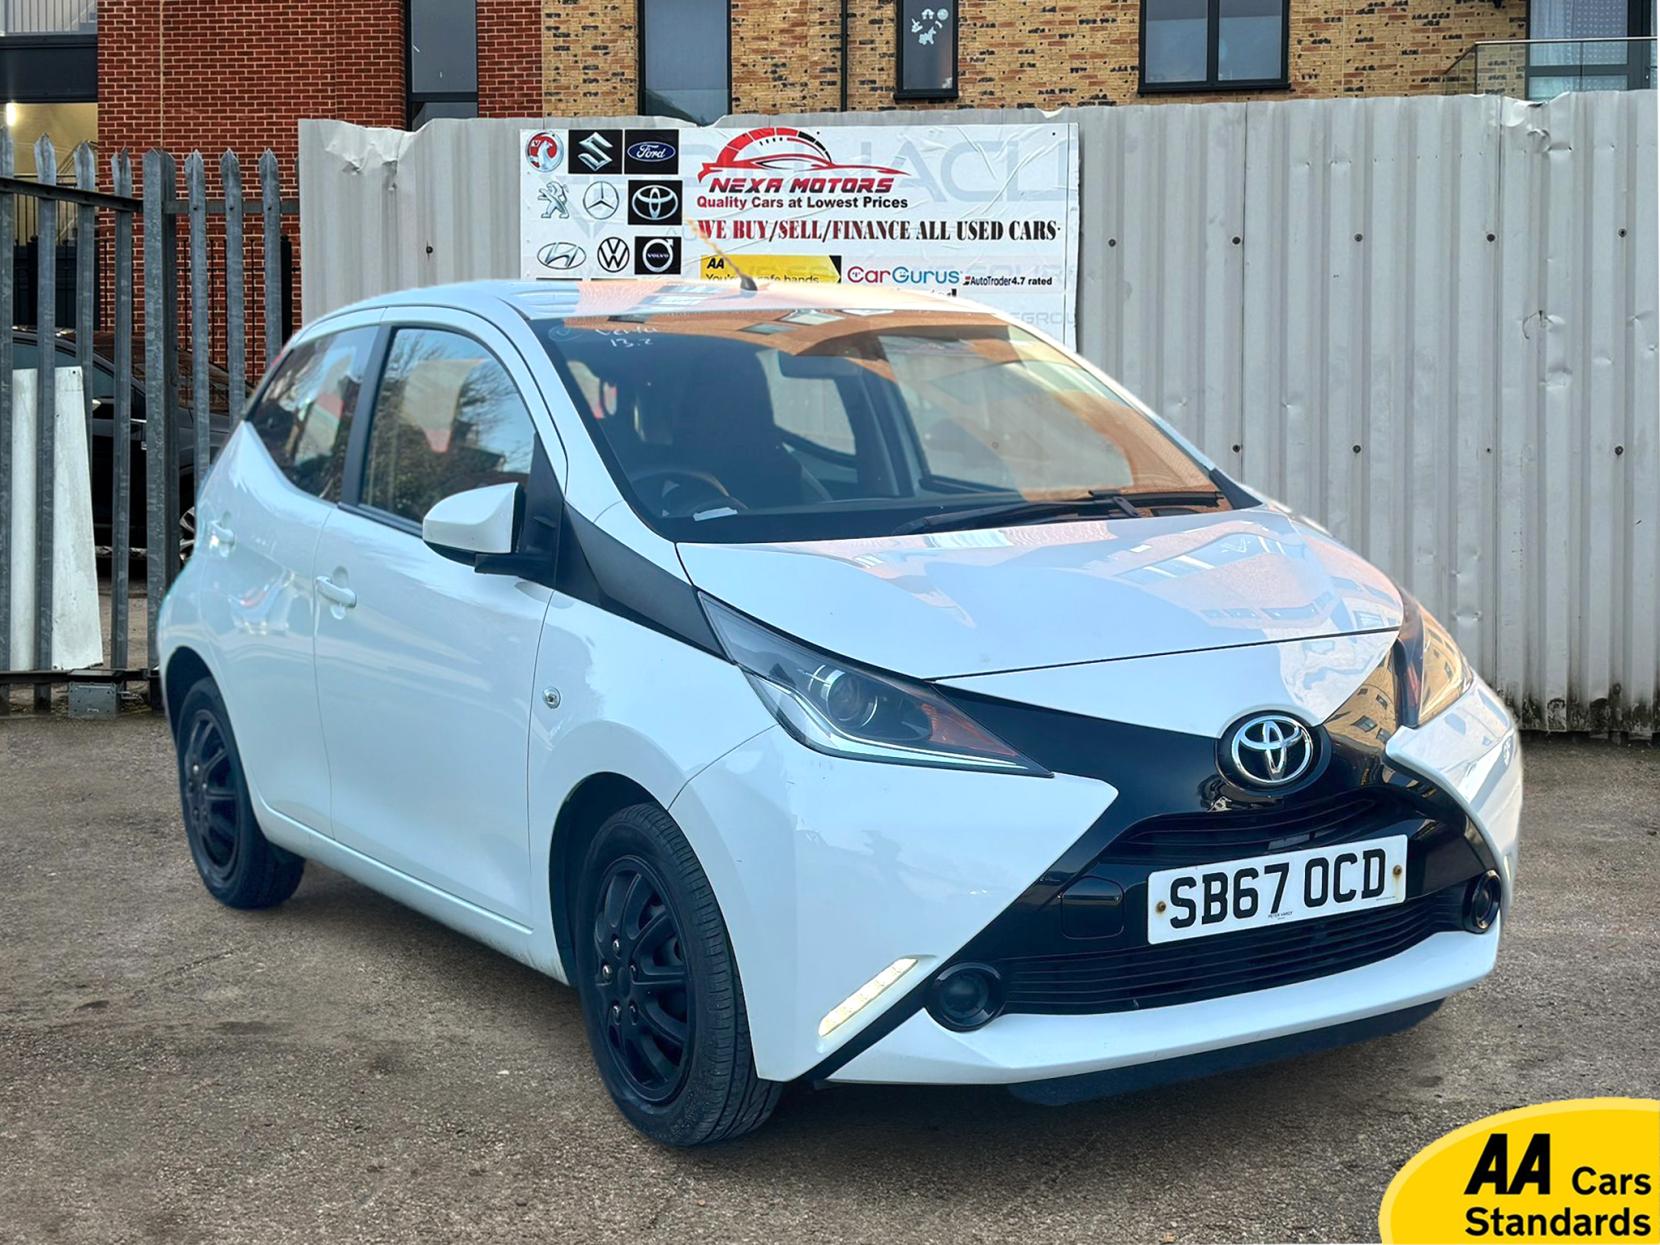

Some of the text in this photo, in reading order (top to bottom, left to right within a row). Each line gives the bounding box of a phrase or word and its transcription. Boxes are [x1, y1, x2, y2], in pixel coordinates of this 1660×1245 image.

[636, 145, 666, 159] Ford
[709, 178, 894, 193] NEXA MOTORS
[697, 196, 908, 210] Quality Cars at Lowest Prices
[697, 220, 727, 240] WE
[733, 220, 911, 242] BUY/SELL/FINANCE
[916, 221, 951, 240] ALL
[957, 221, 1003, 240] USED
[1009, 221, 1057, 240] CARS
[707, 257, 725, 269] AA
[847, 266, 960, 284] CarGurus
[1028, 277, 1053, 286] rated
[1170, 848, 1386, 929] SB67 OCD
